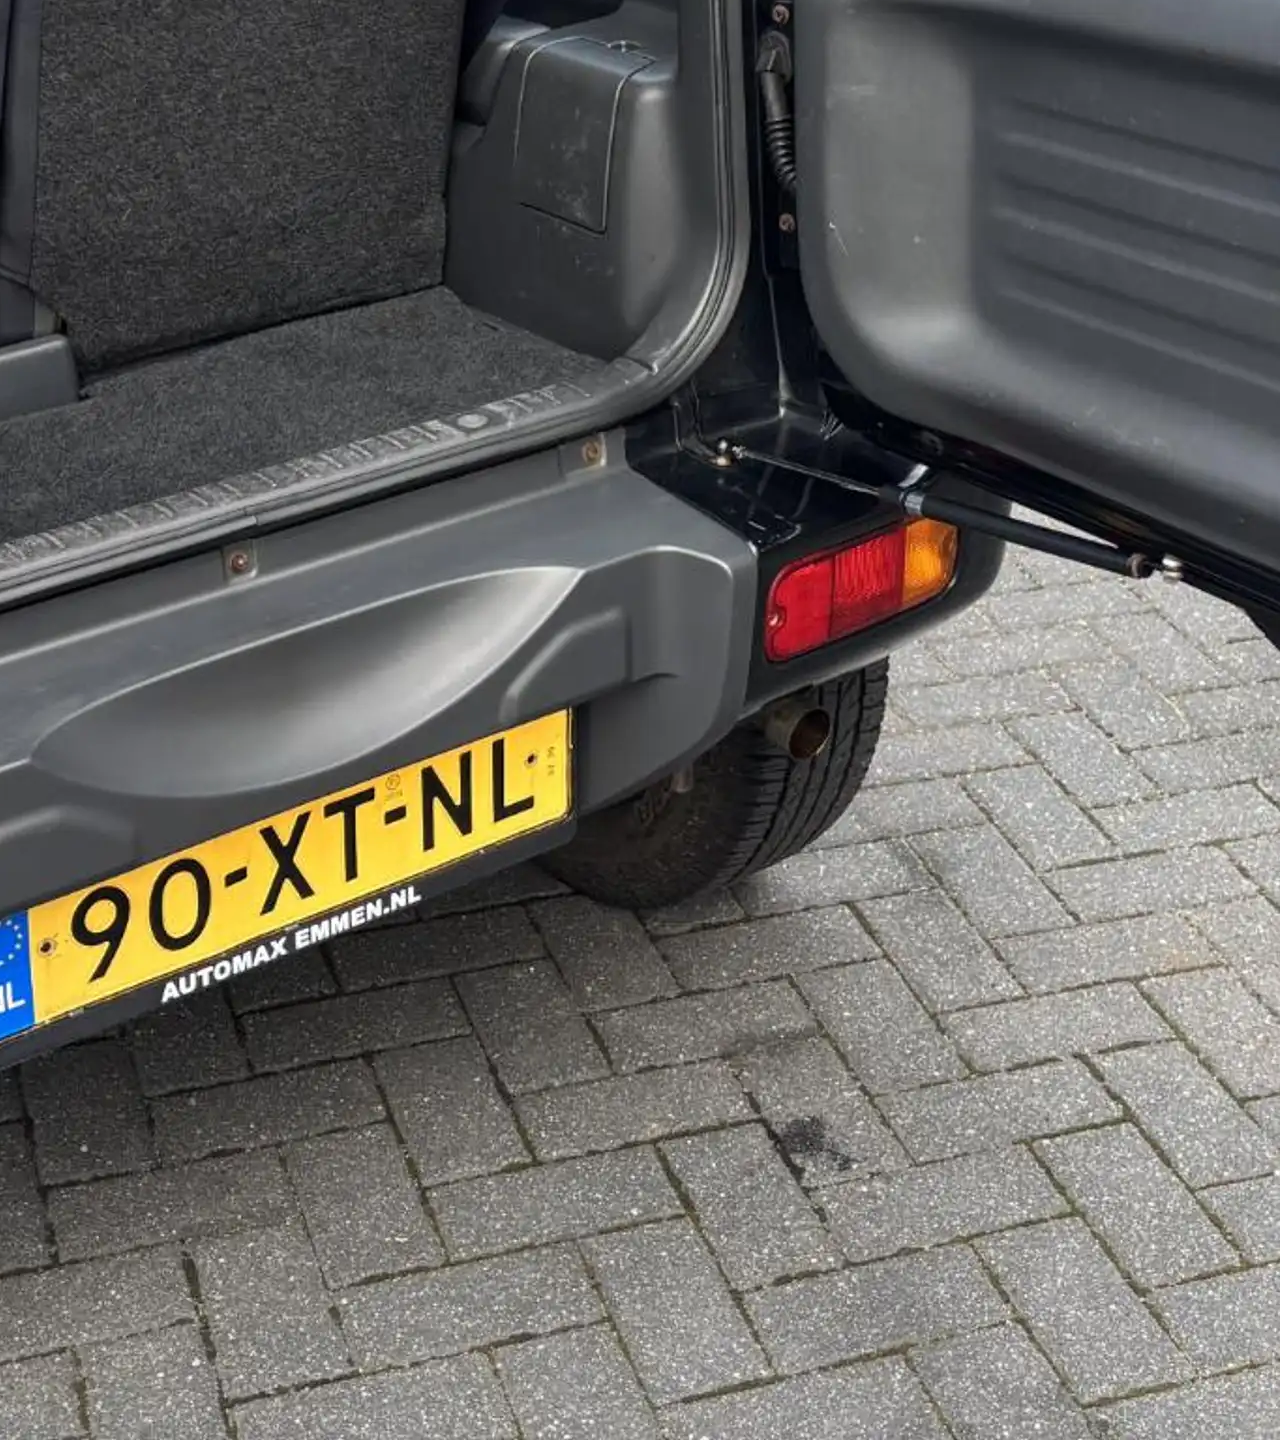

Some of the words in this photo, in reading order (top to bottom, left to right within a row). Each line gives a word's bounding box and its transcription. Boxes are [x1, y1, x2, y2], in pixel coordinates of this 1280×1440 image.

[70, 738, 536, 983] 90-XT-NL
[160, 938, 288, 1005] AUTOMAX
[294, 885, 423, 953] EMMEN.NL
